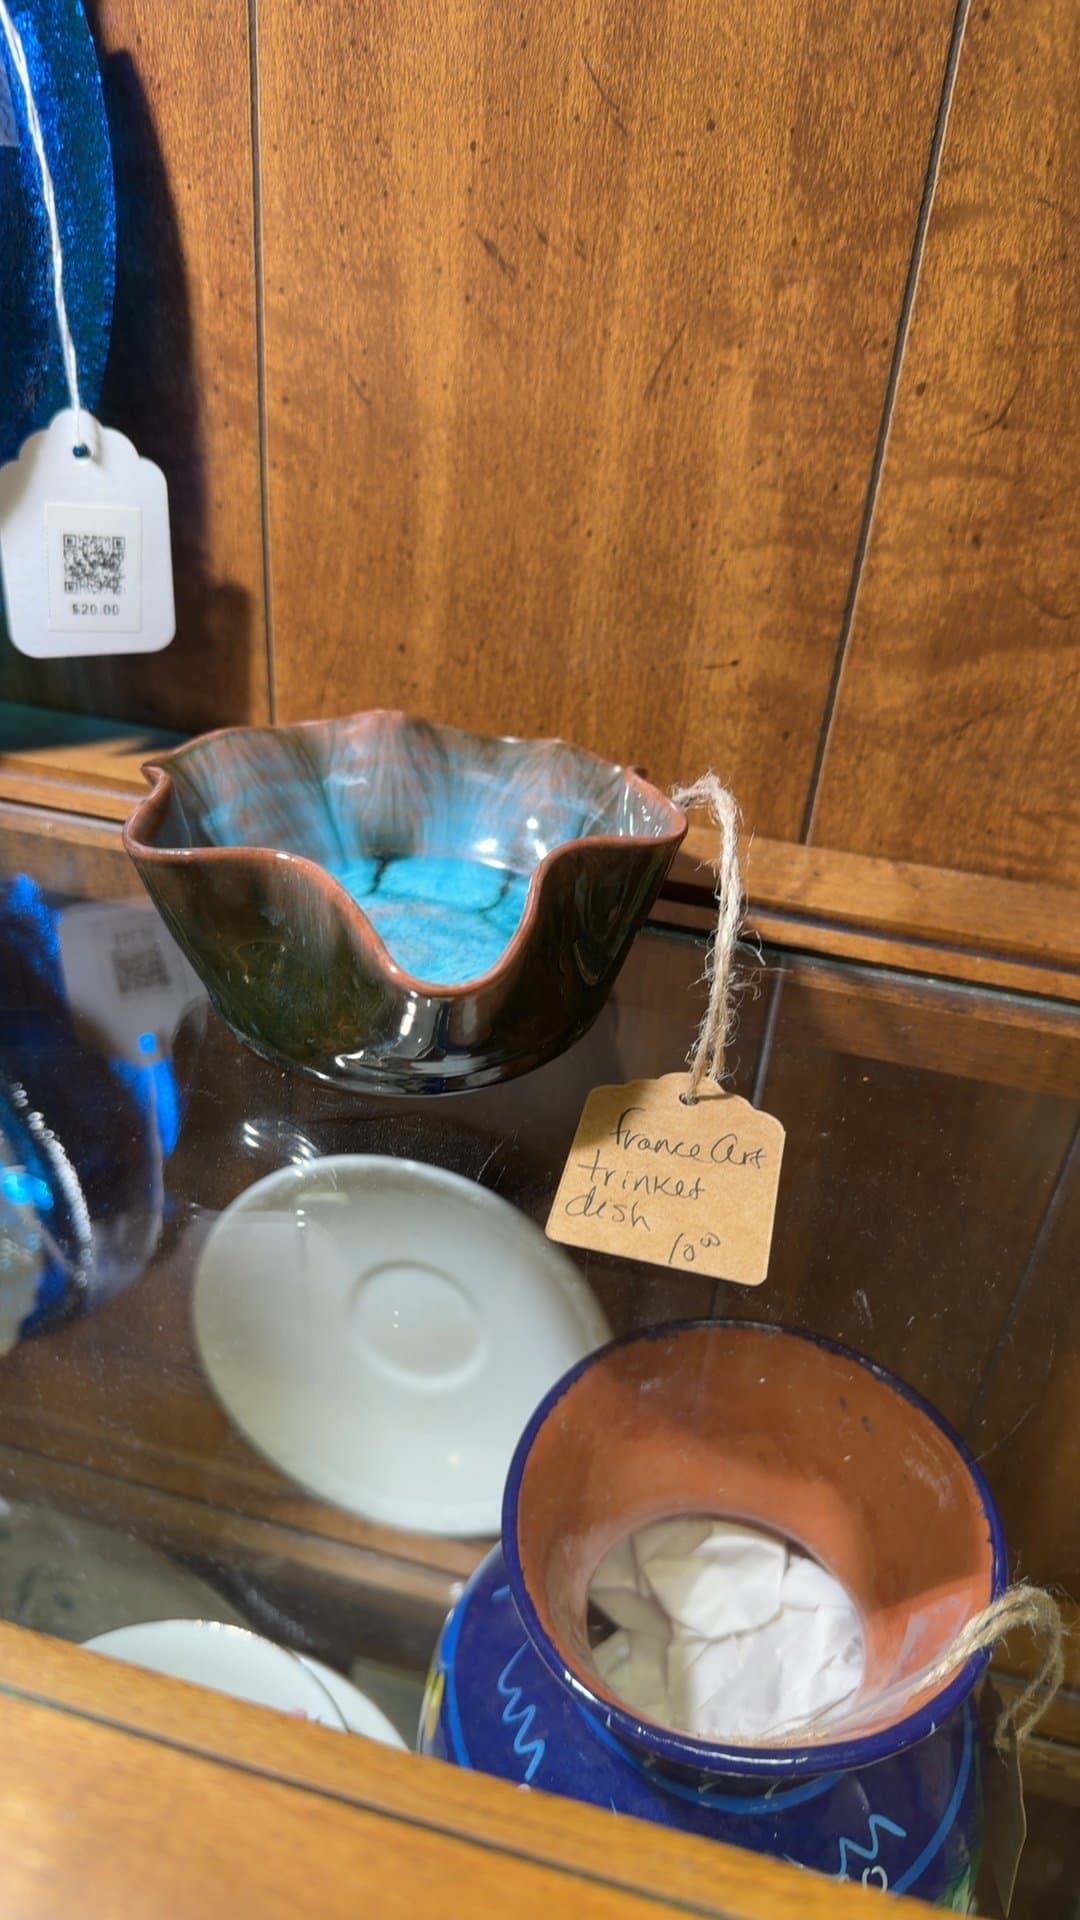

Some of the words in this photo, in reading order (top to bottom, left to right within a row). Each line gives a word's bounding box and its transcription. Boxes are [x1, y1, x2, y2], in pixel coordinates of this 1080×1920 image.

[71, 604, 121, 616] $20.00
[577, 1149, 706, 1200] trinket
[564, 1186, 651, 1232] dish
